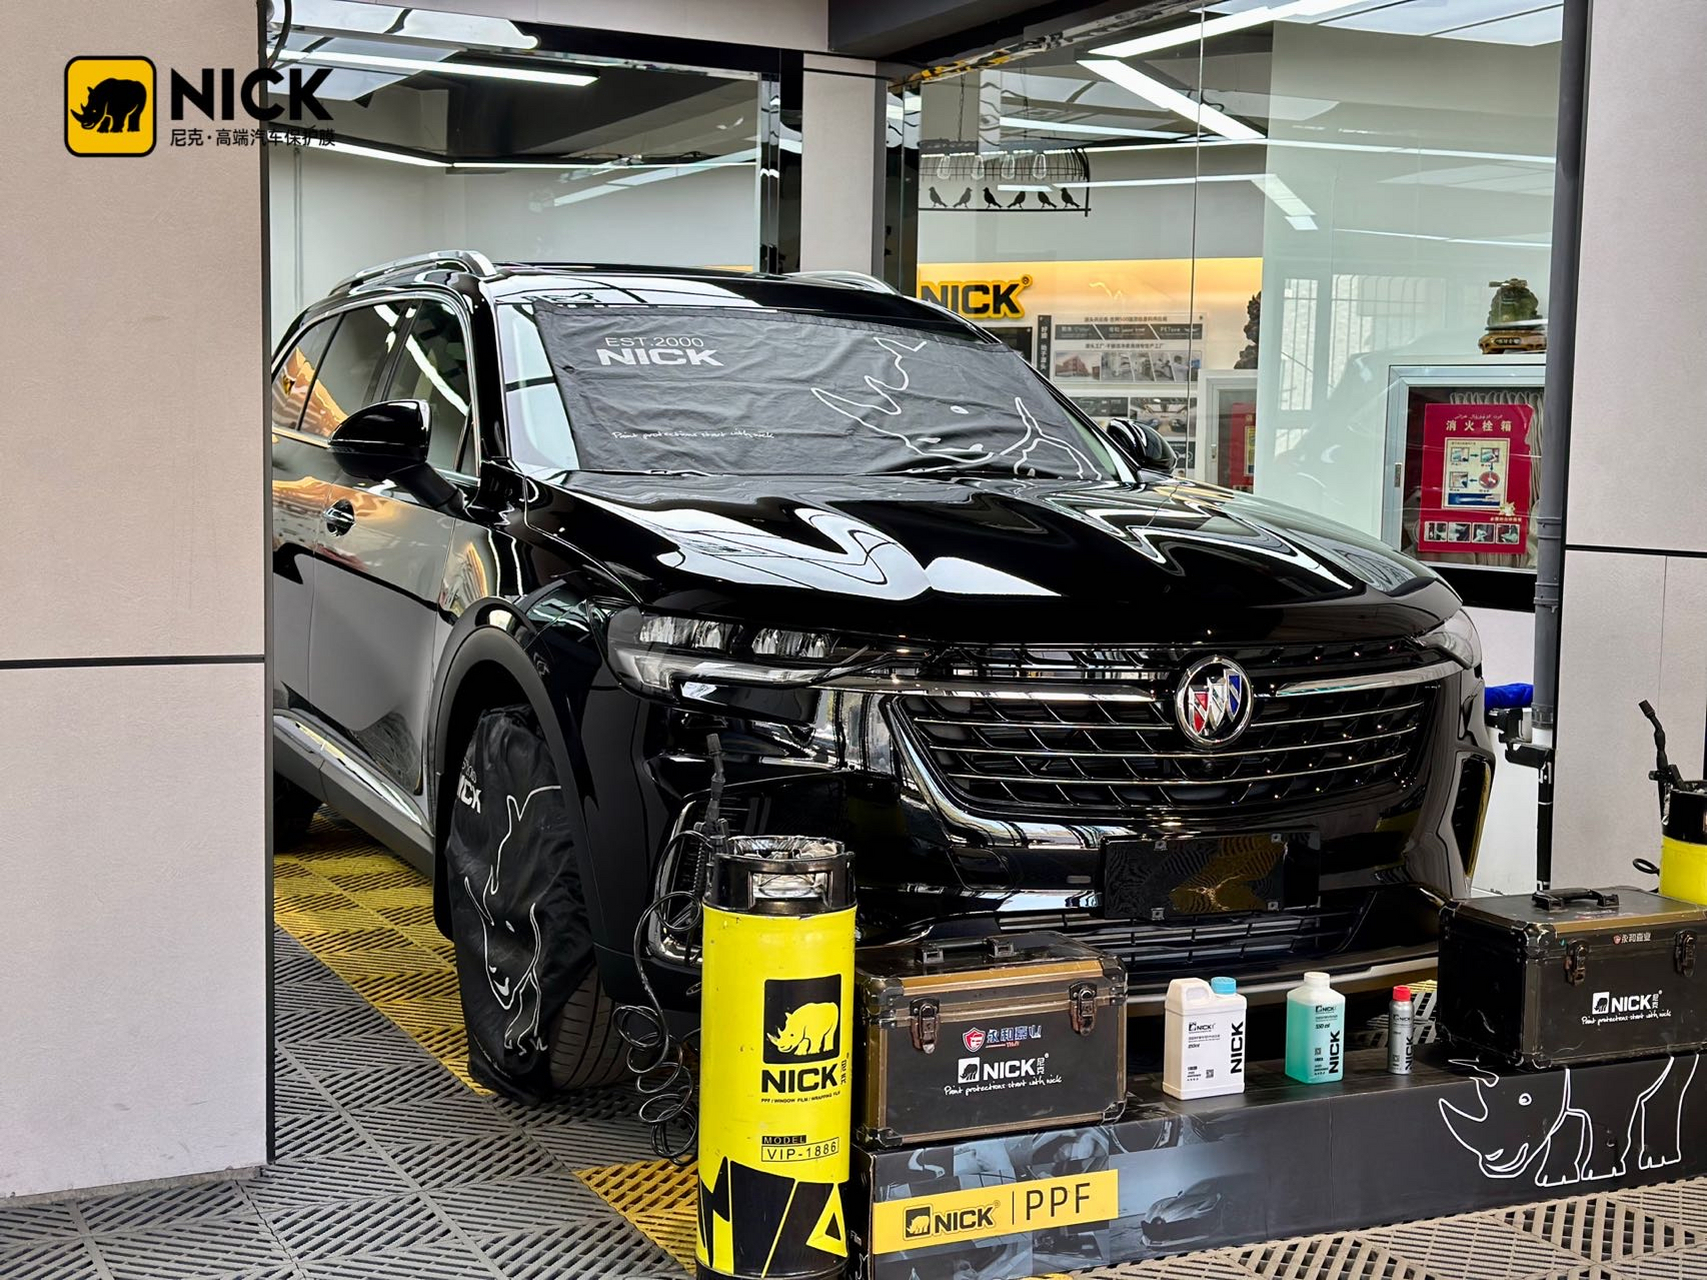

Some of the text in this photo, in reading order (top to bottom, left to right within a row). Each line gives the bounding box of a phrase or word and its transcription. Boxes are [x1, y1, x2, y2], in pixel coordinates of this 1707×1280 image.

[604, 336, 704, 347] EST.2000
[596, 348, 724, 366] NICK
[1445, 420, 1512, 432] 消火栓箱
[457, 774, 482, 814] ICK
[1611, 994, 1652, 1013] NICK
[1230, 1020, 1244, 1074] NICK
[1328, 1030, 1341, 1074] NICK
[1405, 1036, 1414, 1070] NICK
[761, 1063, 838, 1094] NICK
[983, 1058, 1036, 1081] NICK
[763, 1135, 806, 1144] MODEL
[767, 1141, 837, 1160] VIP-1886
[934, 1182, 1091, 1234] NICK PPF
